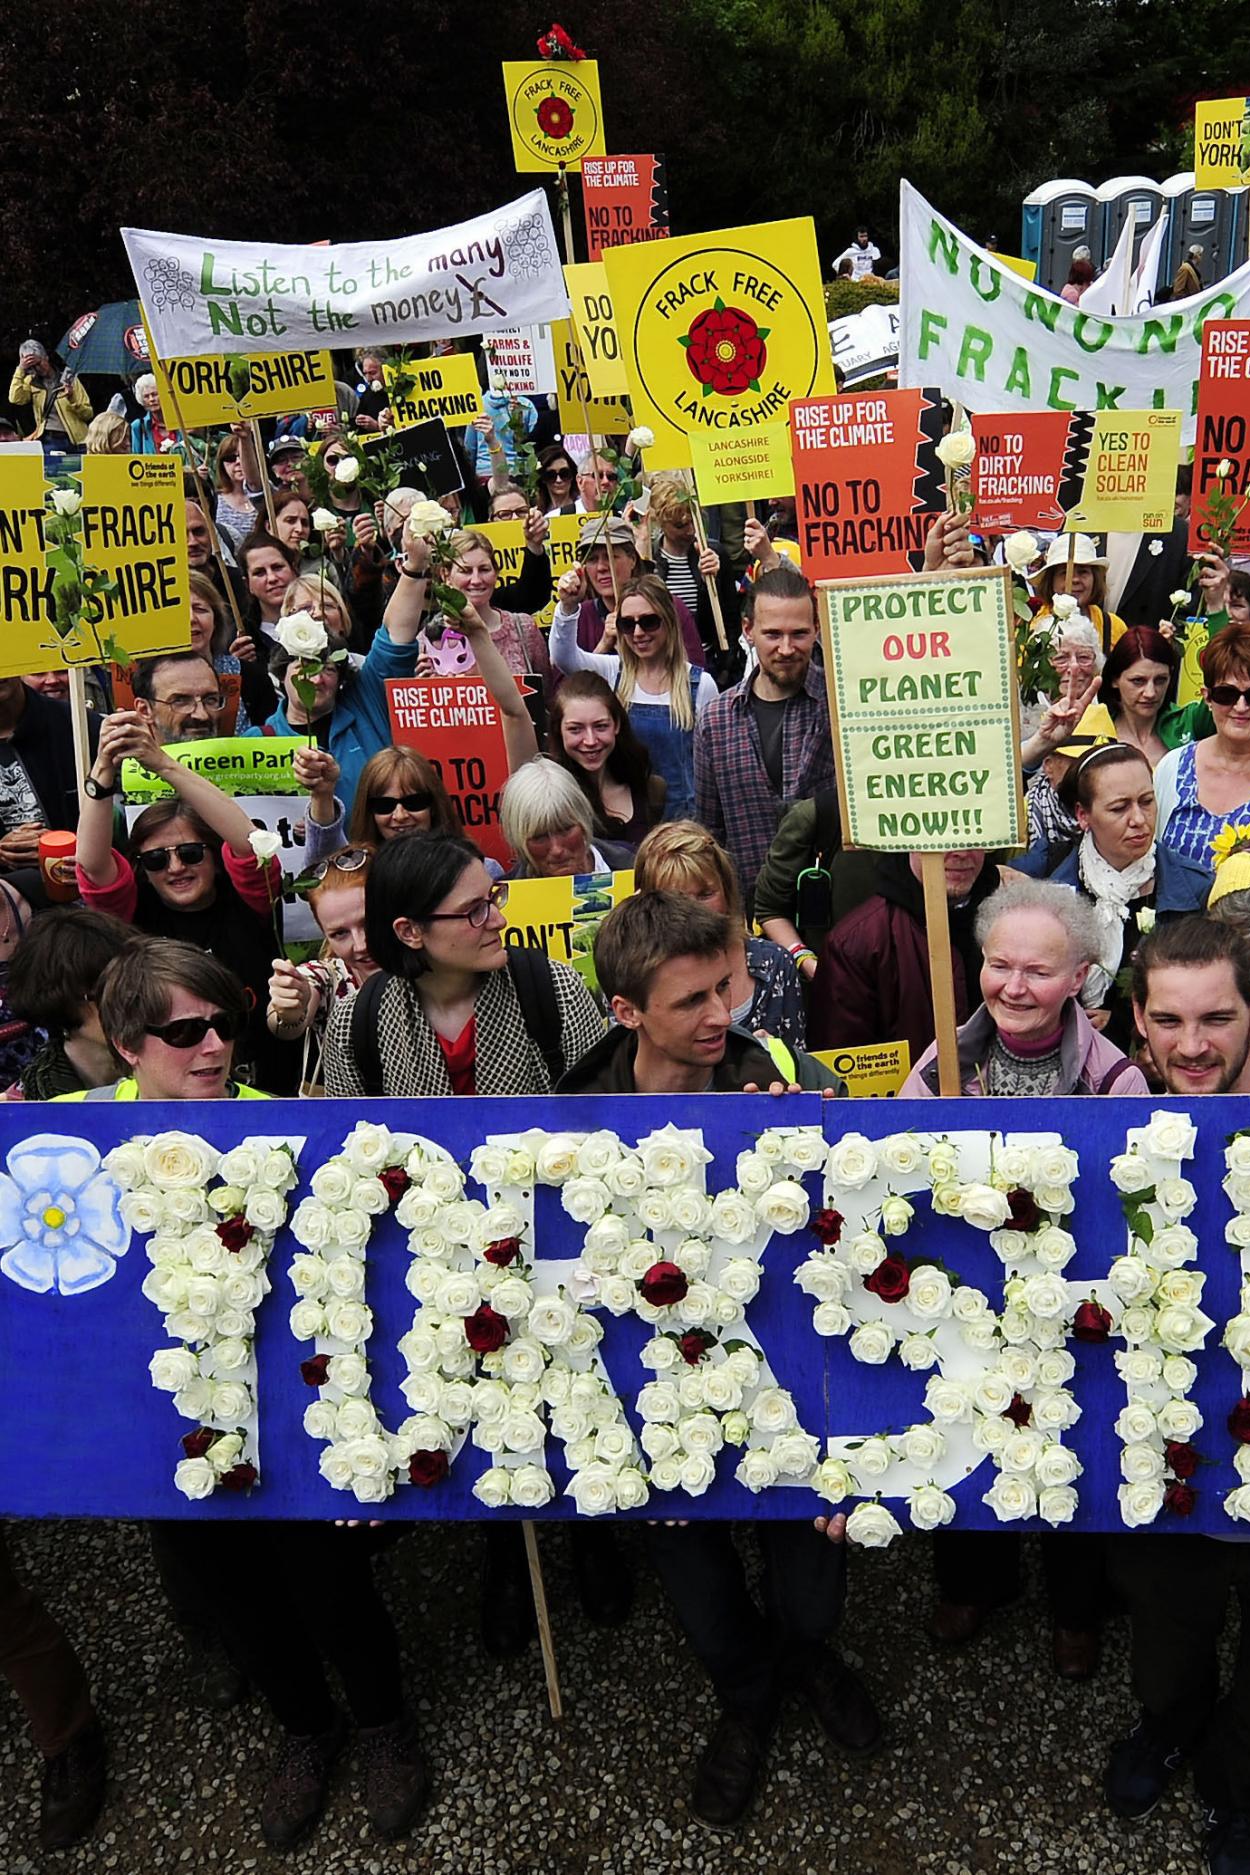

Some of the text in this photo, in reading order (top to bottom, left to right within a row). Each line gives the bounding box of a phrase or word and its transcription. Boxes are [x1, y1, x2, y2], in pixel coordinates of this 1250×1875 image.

[525, 79, 582, 101] FRACK FREE
[1204, 120, 1242, 140] DON'T
[531, 135, 584, 157] LANCASHIRE
[1199, 144, 1241, 167] YORK
[584, 161, 634, 174] RISE UP FOR
[584, 174, 640, 187] THE CLIMATE
[589, 206, 632, 227] NO TO
[200, 236, 506, 297] Listen to the many
[655, 270, 719, 320] FRACK
[733, 271, 783, 312] FREE
[929, 218, 1001, 302] NO
[1024, 294, 1114, 354] NO
[207, 285, 463, 336] Not the money
[487, 339, 520, 350] FARMS
[1209, 331, 1249, 353] RISE
[490, 354, 532, 366] WILDLIFE
[1207, 356, 1242, 378] THE
[250, 351, 325, 393] SHIRE
[419, 369, 442, 391] NO
[397, 393, 477, 421] FRACKING
[673, 381, 792, 428] LANCASHIRE
[795, 401, 887, 428] RISE UP FOR
[708, 436, 770, 452] LANCASHIRE
[796, 423, 894, 450] THE CLIMATE
[979, 435, 1023, 454] NO TO
[1099, 432, 1150, 451] YES TO
[1203, 415, 1246, 452] NO
[145, 462, 168, 470] friends
[714, 453, 770, 468] ALONGSIDE
[978, 455, 1023, 475] DIRTY
[1097, 454, 1148, 472] CLEAN
[158, 470, 176, 478] earth
[715, 469, 774, 484] YORKSHIRE!
[1096, 475, 1146, 493] SOLAR
[978, 475, 1054, 496] FRACKING
[802, 479, 880, 518] NO TO
[0, 503, 176, 554] N'T FRACK
[1143, 518, 1163, 528] sun
[0, 566, 58, 622] RK
[842, 585, 987, 622] PROTECT
[882, 631, 951, 660] OUR
[392, 686, 488, 707] RISE UP FOR
[859, 671, 982, 703] PLANET
[395, 707, 497, 728] THE CLIMATE
[871, 730, 976, 760] GREEN
[449, 757, 486, 790] TO
[867, 769, 990, 799] ENERGY
[878, 808, 983, 837] NOW!!!
[856, 1052, 888, 1062] friends
[857, 1059, 899, 1070] the earth
